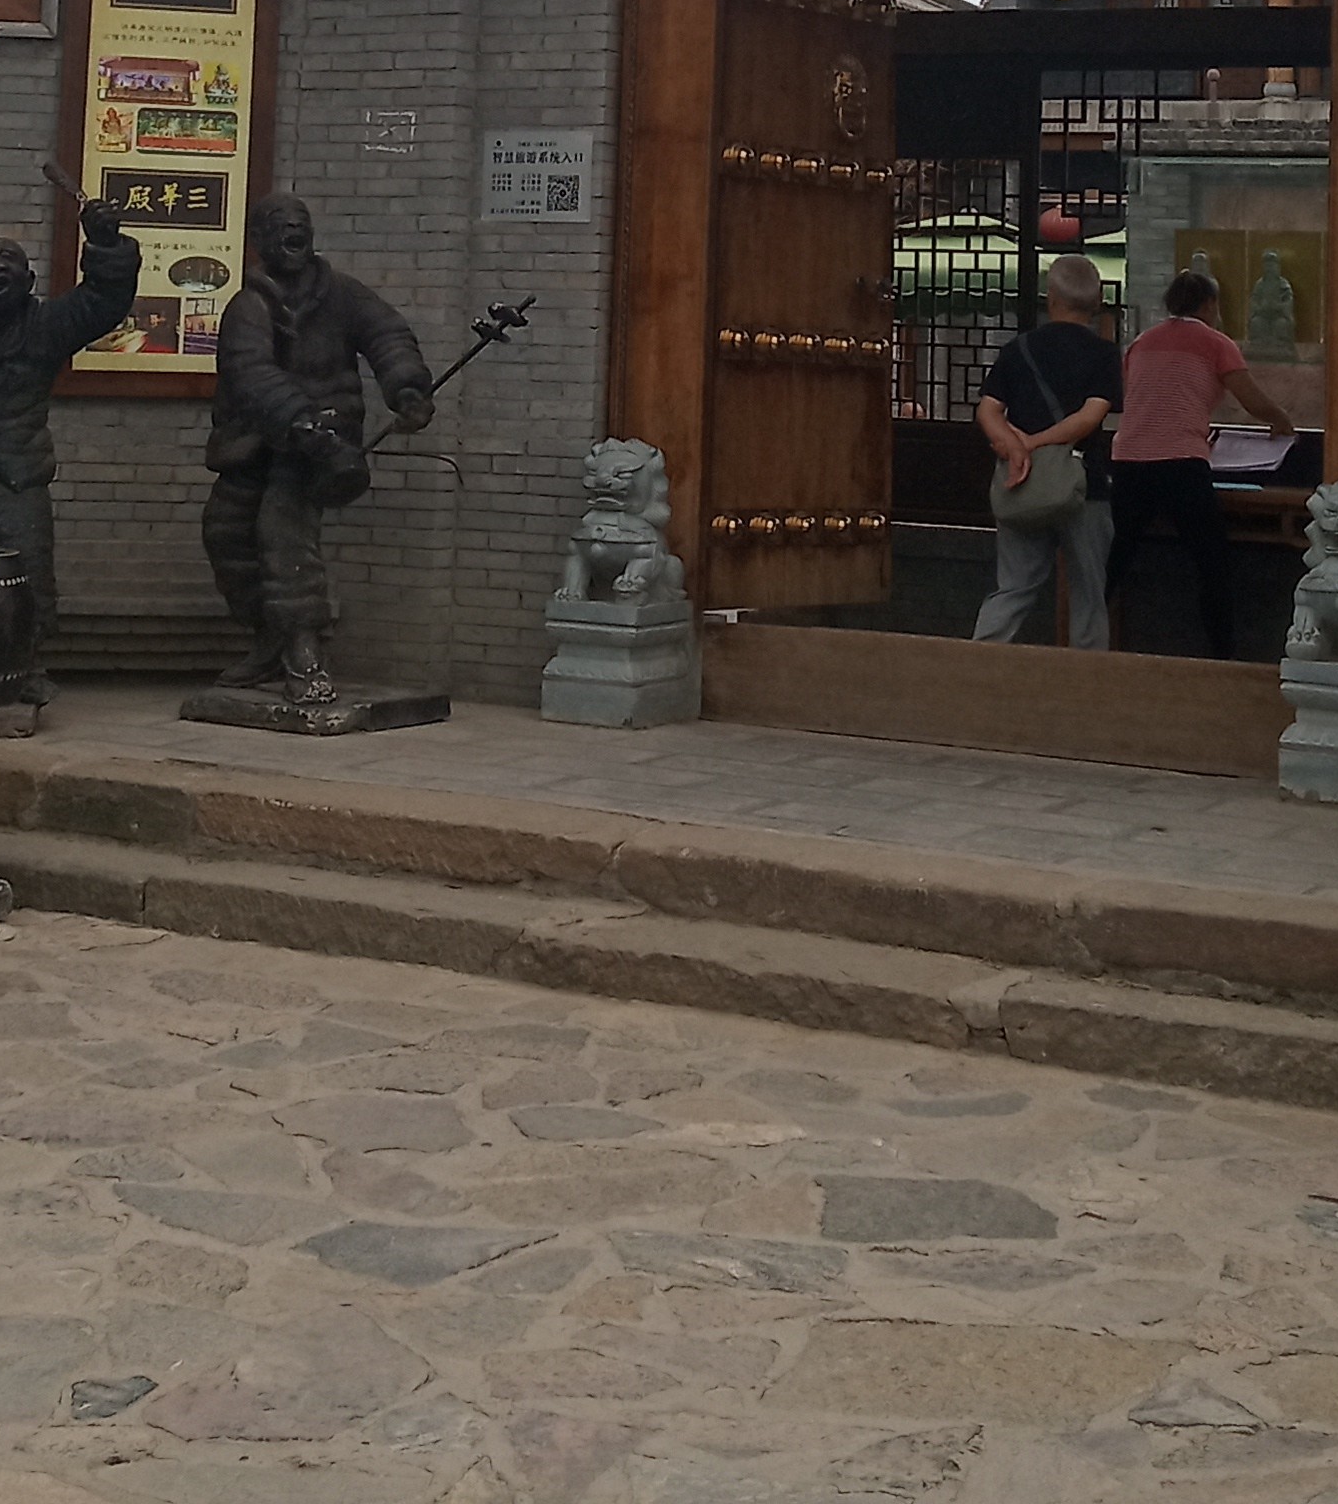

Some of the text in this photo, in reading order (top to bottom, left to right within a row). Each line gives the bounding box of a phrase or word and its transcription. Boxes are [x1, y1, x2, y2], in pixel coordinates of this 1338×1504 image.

[492, 151, 584, 165] 智慧旅游系统入口
